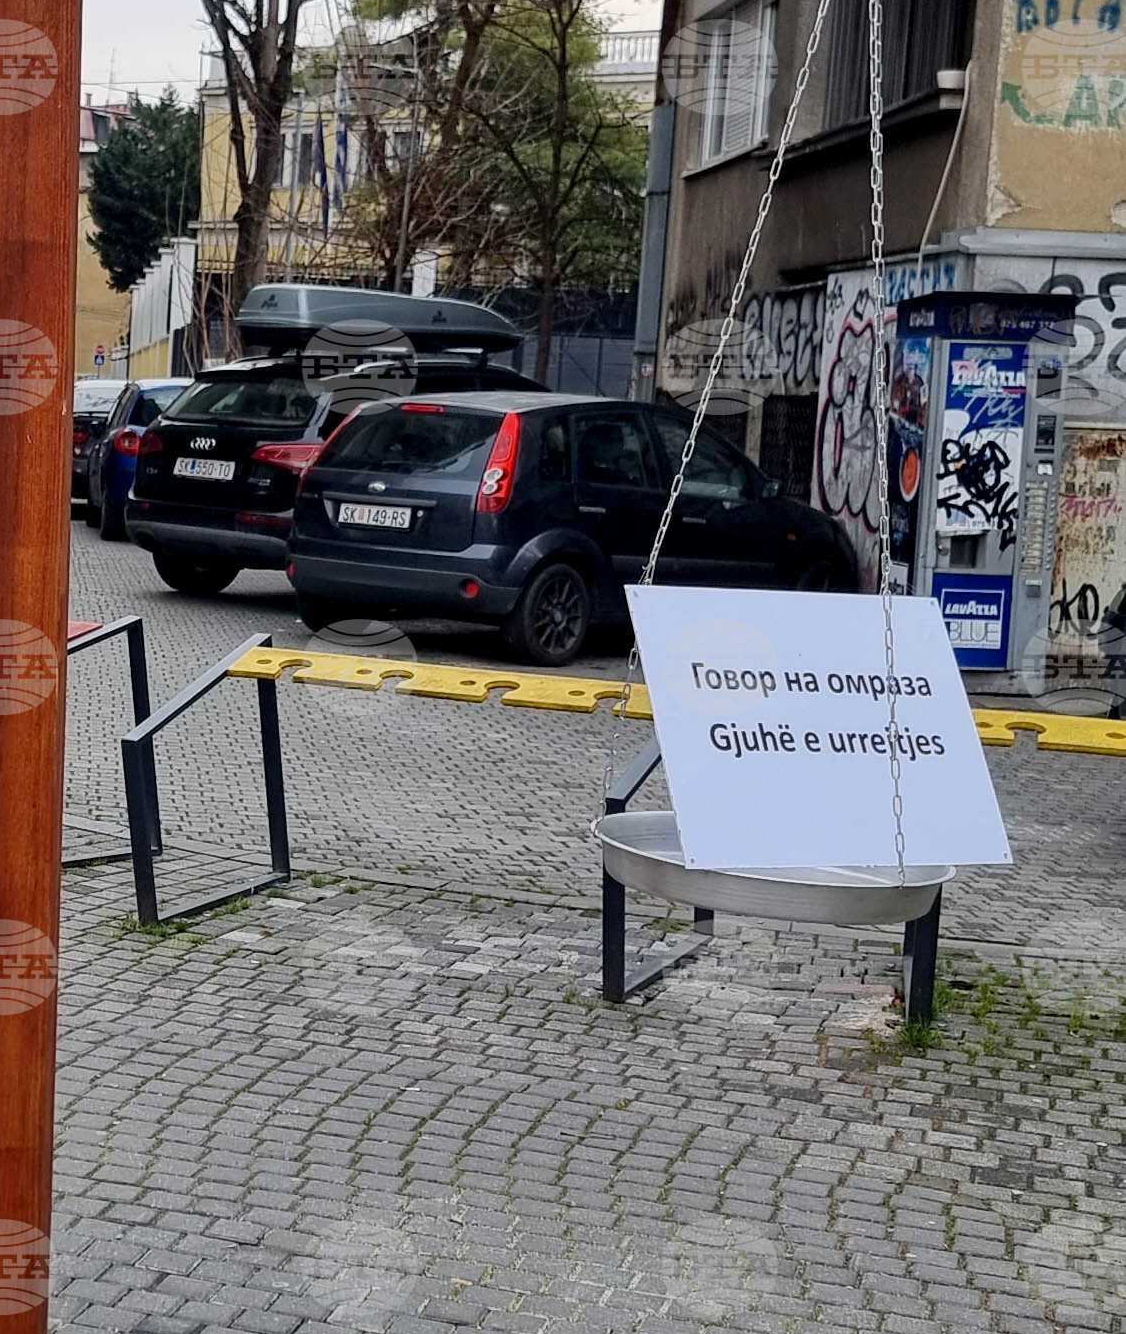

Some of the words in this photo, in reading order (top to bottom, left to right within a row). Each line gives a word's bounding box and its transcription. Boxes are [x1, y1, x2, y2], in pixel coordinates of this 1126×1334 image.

[342, 506, 356, 522] SK
[944, 600, 998, 615] LAVAZZA
[949, 621, 999, 642] BLUE
[691, 662, 777, 698] Говор
[784, 671, 820, 693] на
[827, 672, 933, 701] омраза
[709, 722, 797, 758] Gjuhë
[804, 730, 821, 753] e
